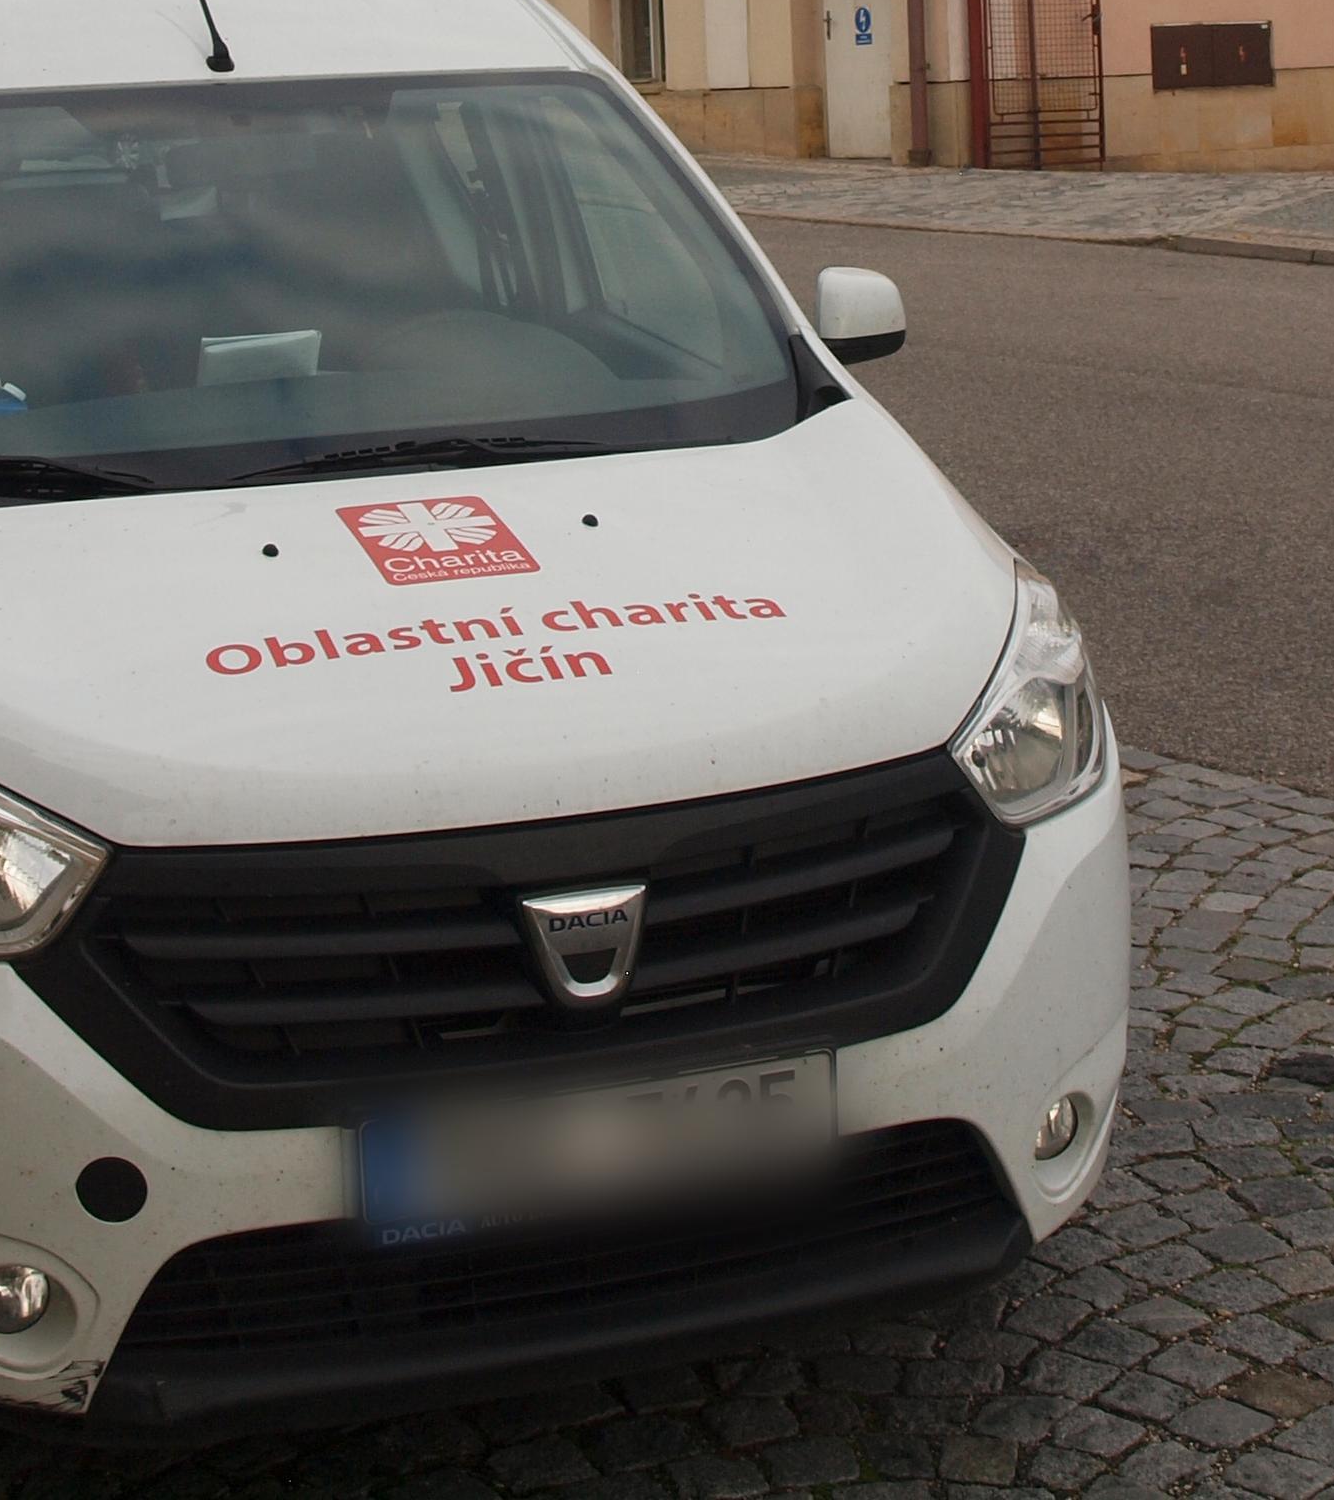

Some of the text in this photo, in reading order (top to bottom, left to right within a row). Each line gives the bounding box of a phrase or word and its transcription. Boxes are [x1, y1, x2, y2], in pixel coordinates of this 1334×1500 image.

[384, 548, 526, 574] Charita
[453, 561, 531, 577] republika
[205, 592, 787, 675] Oblastní charita
[450, 646, 613, 692] Jičín
[548, 908, 628, 933] DACIA
[381, 1218, 467, 1246] DACIA
